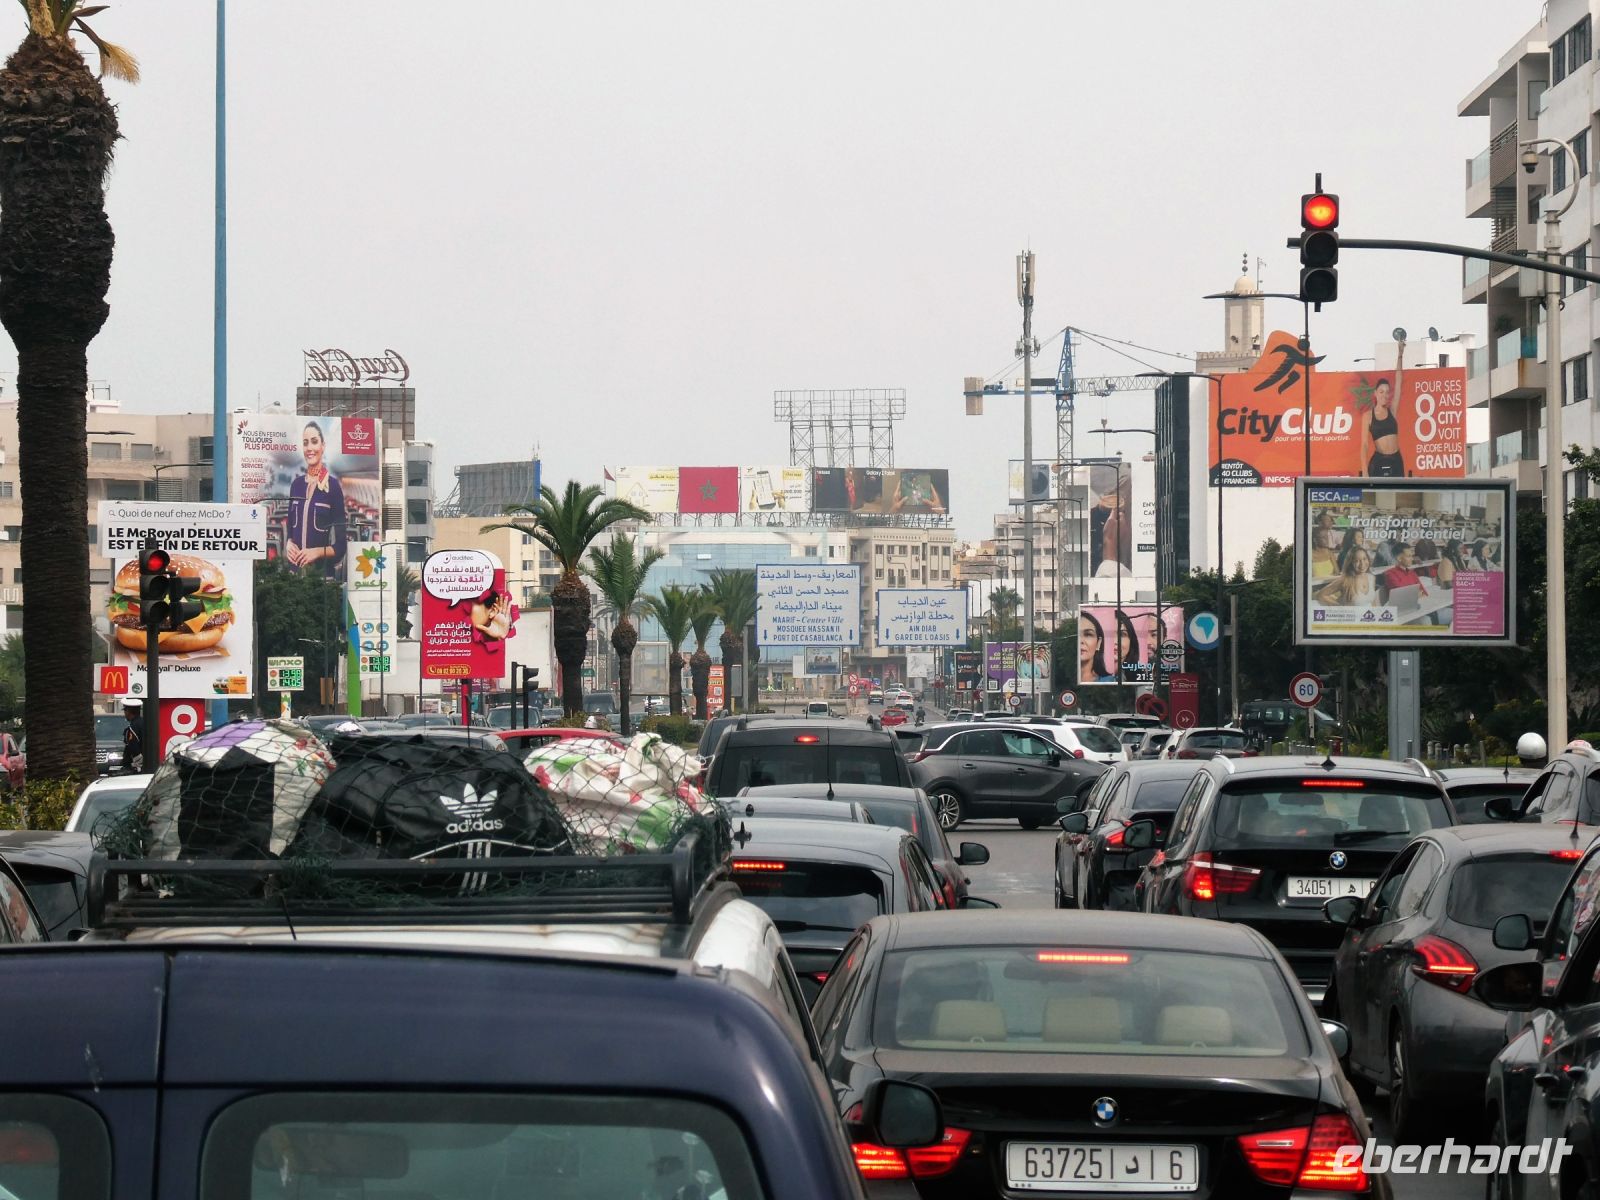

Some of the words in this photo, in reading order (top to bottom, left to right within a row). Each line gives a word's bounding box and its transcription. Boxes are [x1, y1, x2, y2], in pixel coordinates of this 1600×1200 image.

[1415, 381, 1442, 392] POUR
[1445, 380, 1462, 392] SES
[1439, 393, 1462, 406] ANS
[1415, 393, 1436, 442] 8
[1438, 411, 1462, 424] CITY
[1438, 428, 1461, 440] VOIT
[1416, 443, 1442, 453] ENCORE
[1444, 442, 1462, 452] PLUS
[1416, 454, 1462, 470] GRAND
[1312, 492, 1340, 501] ESCA
[118, 509, 139, 518] Quoi
[154, 509, 174, 518] neuf
[176, 509, 196, 518] chez
[199, 510, 224, 518] McDo
[1348, 515, 1436, 530] Transformer
[108, 528, 124, 537] LE
[188, 529, 240, 538] DELUXE
[1365, 529, 1397, 539] mon
[1401, 528, 1465, 542] potentiel
[108, 540, 134, 549] EST
[137, 540, 178, 550] EFIN
[182, 541, 199, 550] DE
[760, 570, 790, 581] المدينة
[768, 586, 793, 598] الثاني
[796, 586, 820, 596] الحسن
[824, 587, 849, 596] مسجد
[822, 602, 842, 612] ميناء
[898, 596, 928, 607] الدياب
[930, 598, 946, 607] عين
[891, 611, 926, 623] الوازيس
[929, 610, 954, 622] محطة
[1300, 684, 1313, 696] 60
[446, 819, 503, 834] adidas
[1297, 880, 1332, 895] 34051
[1025, 1148, 1102, 1178] 63725
[1125, 1155, 1139, 1174] د
[1170, 1150, 1182, 1180] 6
